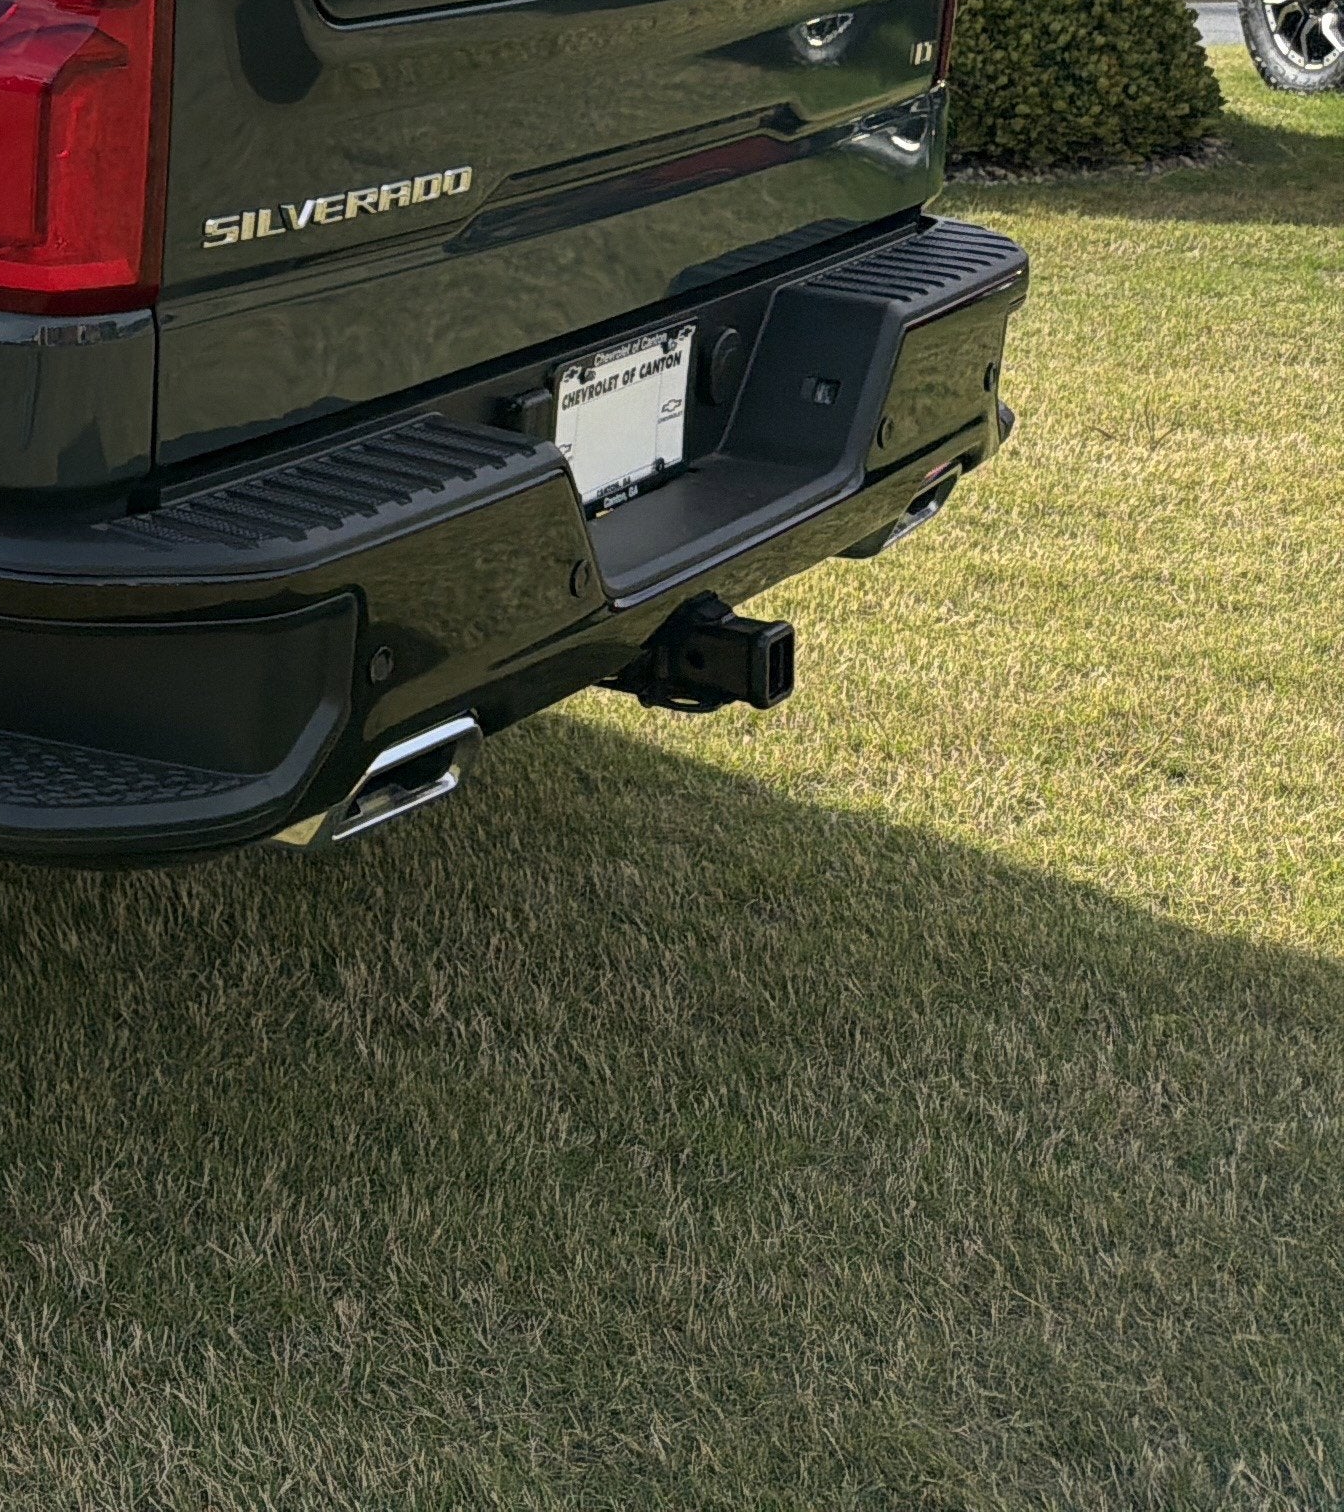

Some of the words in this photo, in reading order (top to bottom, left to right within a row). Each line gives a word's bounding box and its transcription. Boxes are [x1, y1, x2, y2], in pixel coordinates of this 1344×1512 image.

[202, 166, 473, 248] SILVERADO
[561, 373, 620, 411] CHEVROLET
[622, 367, 637, 386] OF
[639, 350, 683, 379] CANTON
